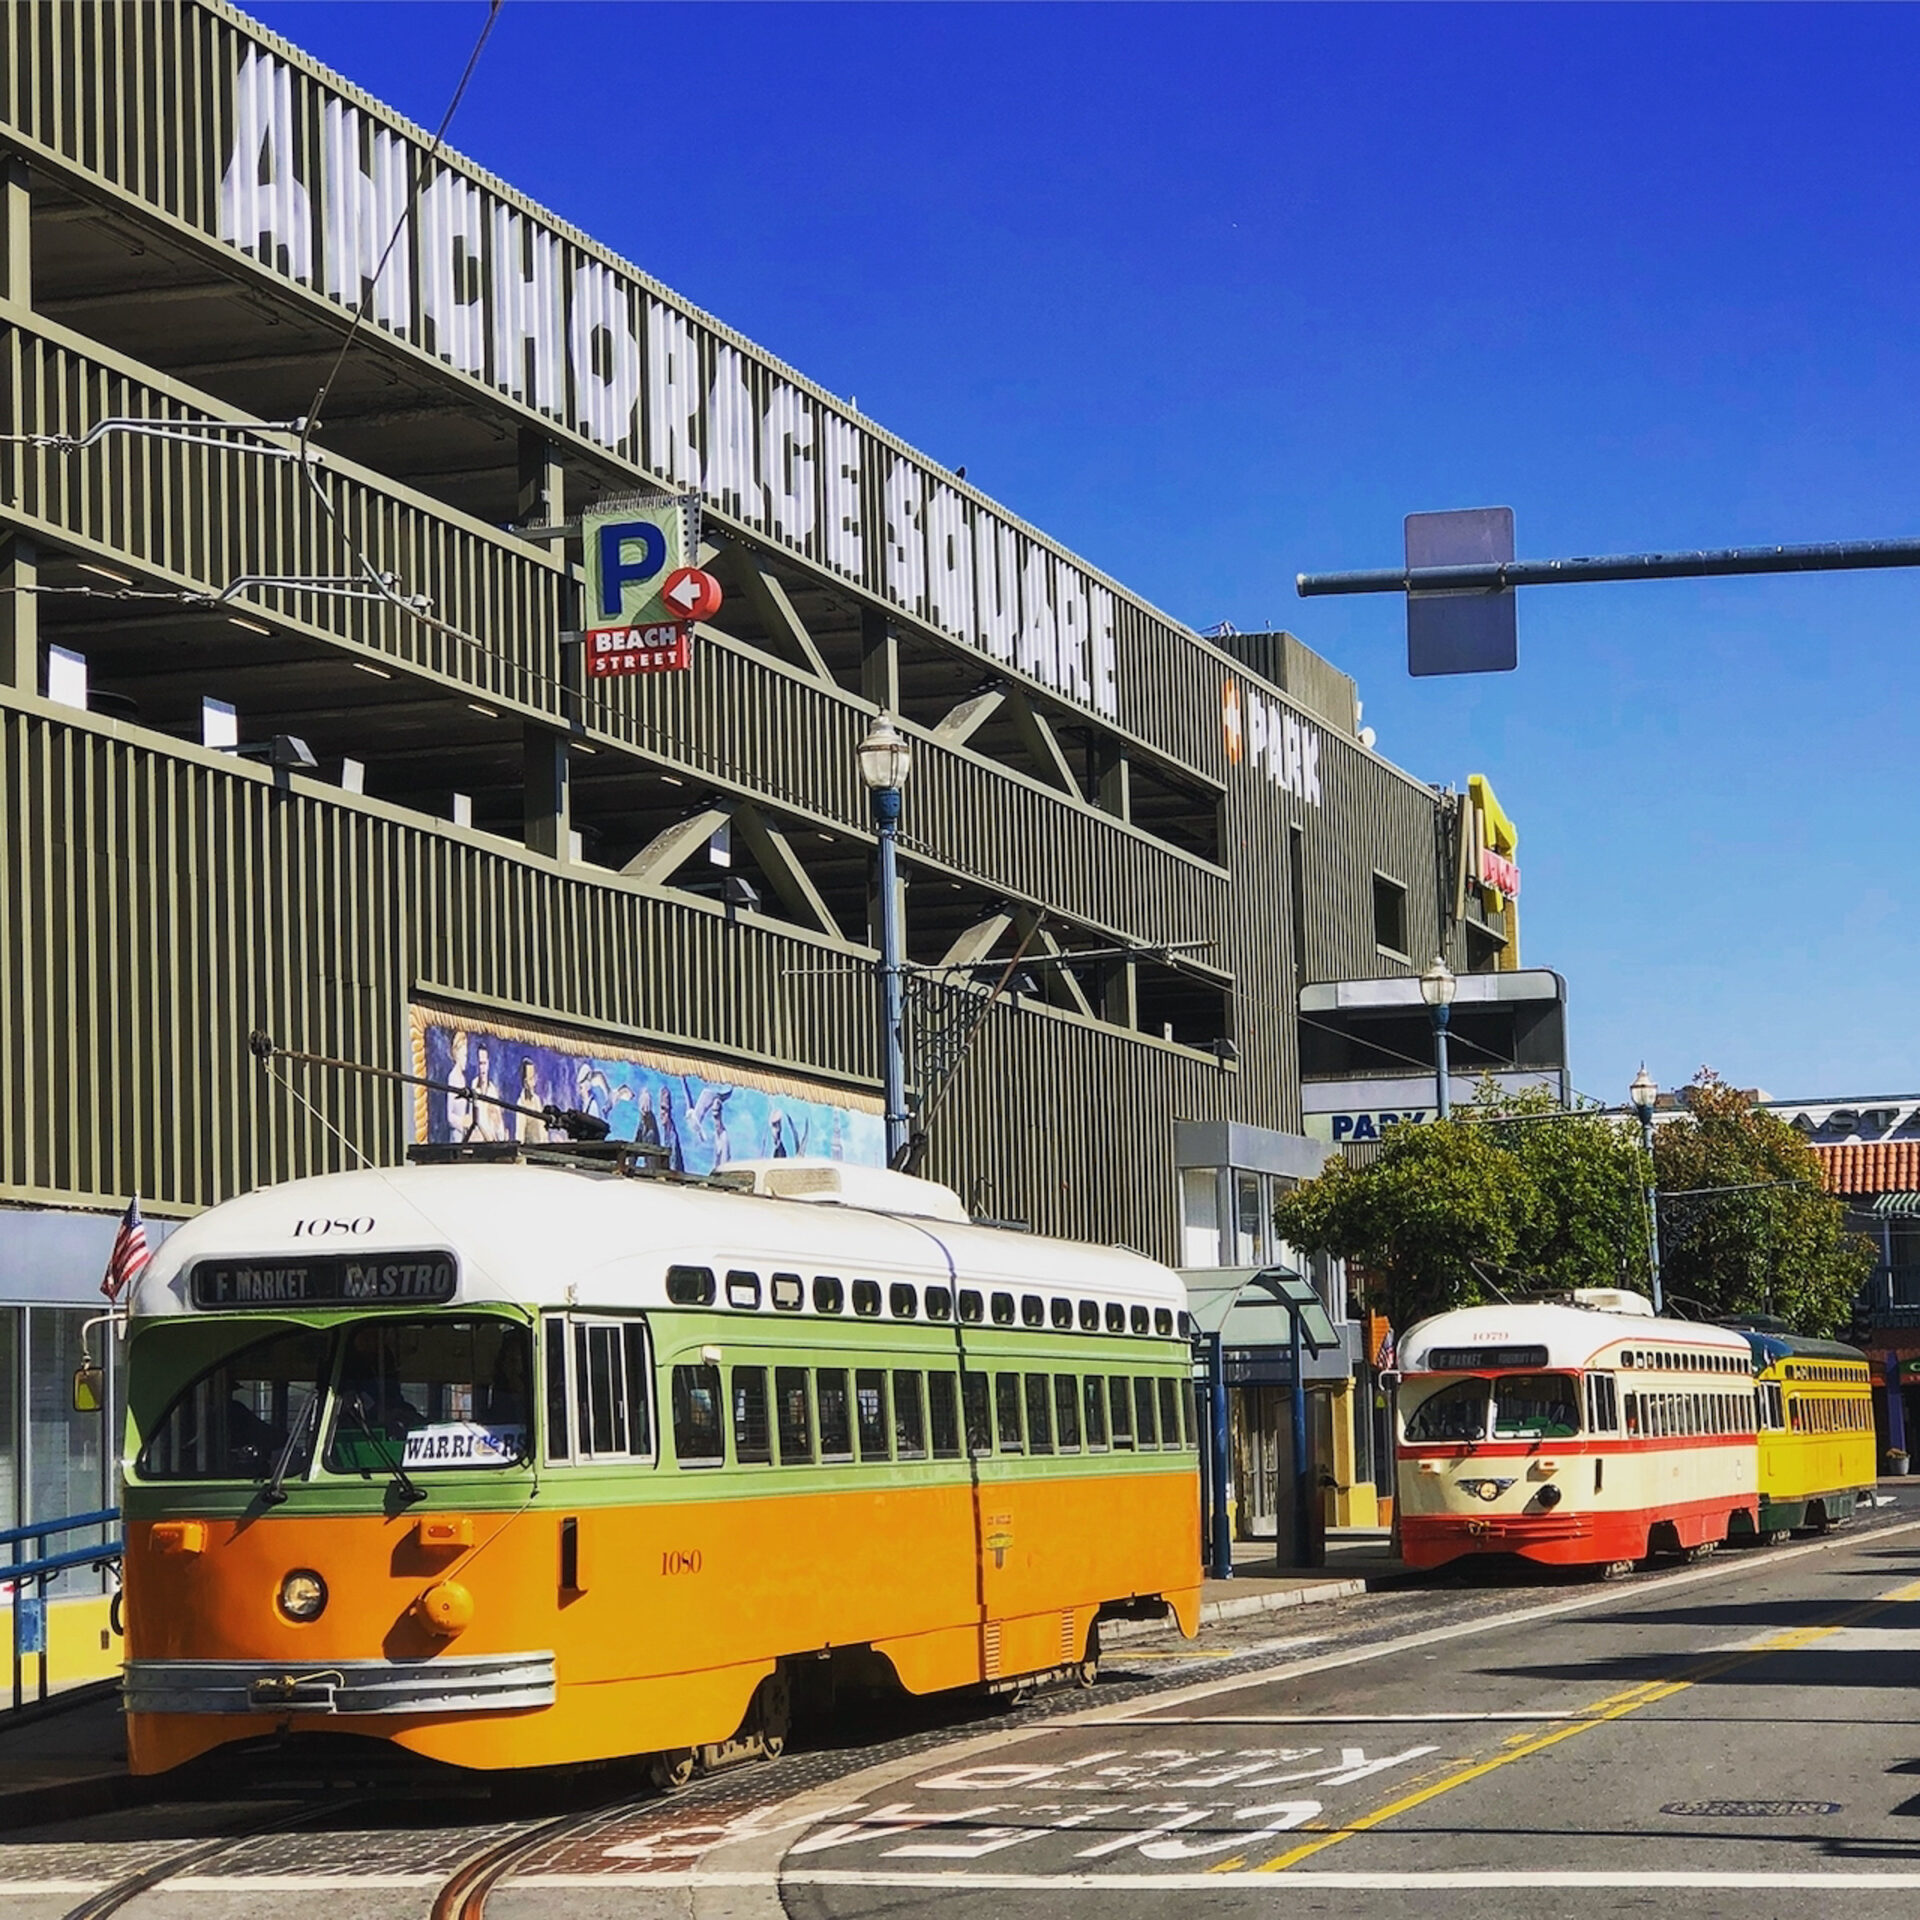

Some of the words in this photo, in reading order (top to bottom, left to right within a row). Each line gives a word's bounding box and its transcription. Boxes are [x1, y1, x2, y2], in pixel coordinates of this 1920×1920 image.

[220, 41, 862, 582] ANCHORAGE
[886, 456, 1117, 720] SQUARE
[599, 521, 667, 617] P
[595, 626, 677, 652] BEACH
[595, 652, 677, 671] STREET
[1248, 691, 1320, 808] PARK
[291, 1216, 375, 1238] 1080
[216, 1271, 228, 1300] F
[236, 1268, 308, 1300] MARKET
[343, 1264, 450, 1297] CASTRO
[661, 1549, 702, 1576] 1080
